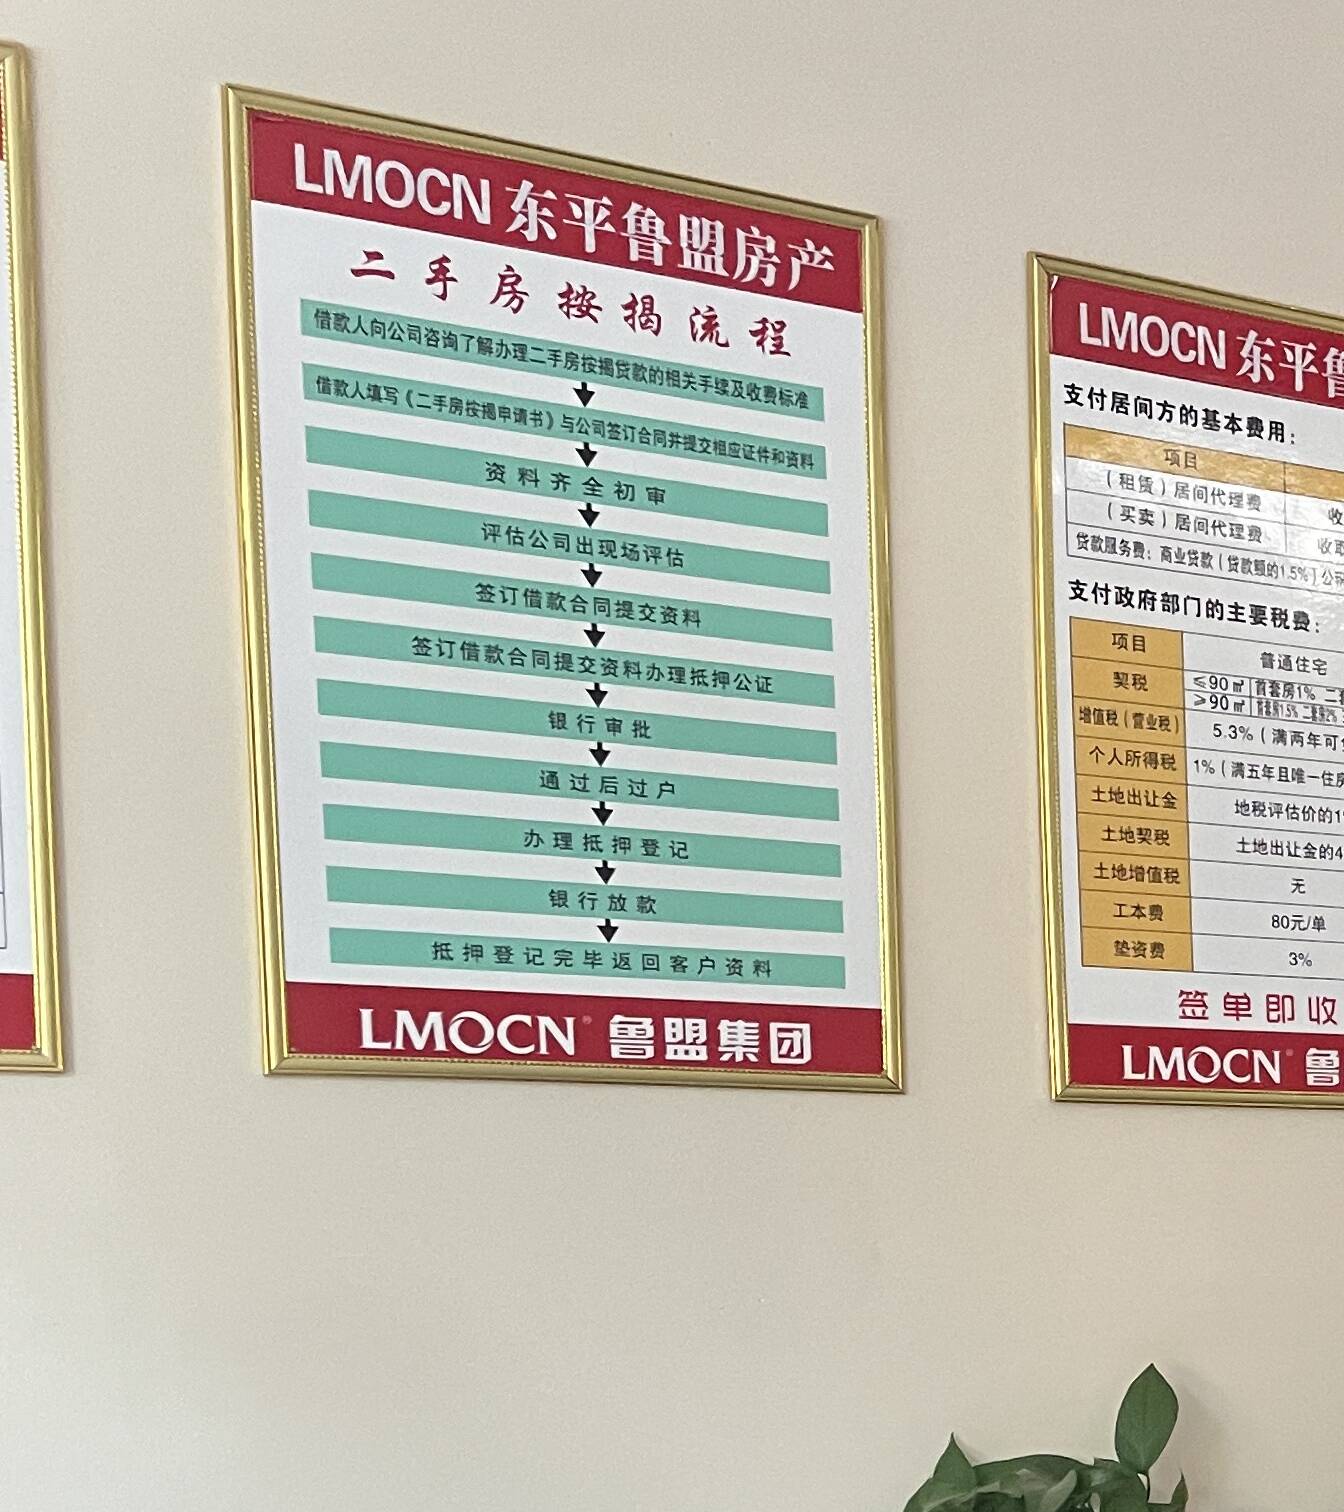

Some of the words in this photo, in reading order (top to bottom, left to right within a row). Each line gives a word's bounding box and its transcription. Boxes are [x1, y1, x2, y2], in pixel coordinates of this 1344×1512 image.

[293, 143, 491, 225] LMOCN
[504, 180, 834, 292] 东平鲁盟房产
[351, 248, 792, 357] 二手房按揭流程
[1078, 302, 1225, 369] LMOCN
[314, 309, 810, 410] 借款人向公司咨询了解办理二手房按揭贷款的相关手续及收费标准
[1164, 449, 1198, 469] 项目
[485, 462, 667, 506] 资料齐全初审
[481, 523, 685, 568] 评估公司出现场评估
[474, 582, 702, 627] 签订借款合同提交资料
[1112, 633, 1146, 653] 项目
[411, 636, 774, 695] 签订借款合同提交资料办理抵押公证
[1260, 651, 1328, 676] 普通住宅
[1113, 672, 1148, 691] 契税
[548, 711, 652, 740] 银行审批
[1089, 746, 1177, 772] 个人所得税
[539, 770, 677, 798] 通过后过户
[1091, 787, 1178, 809] 土地出让金
[523, 829, 689, 859] 办理抵押登记
[1102, 826, 1170, 846] 土地契税
[1093, 863, 1180, 885] 土地增值税
[1291, 878, 1306, 894] 无
[548, 889, 657, 914] 银行放款
[1113, 903, 1164, 921] 工本费
[1271, 914, 1327, 932] 80元/单
[432, 942, 773, 977] 抵押登记完毕返回客户资料
[1114, 940, 1165, 960] 垫资费
[1289, 951, 1313, 968] 3%
[359, 1008, 576, 1056] LMOCN
[609, 1014, 812, 1064] 鲁盟集团
[1122, 1044, 1281, 1084] LMOCN
